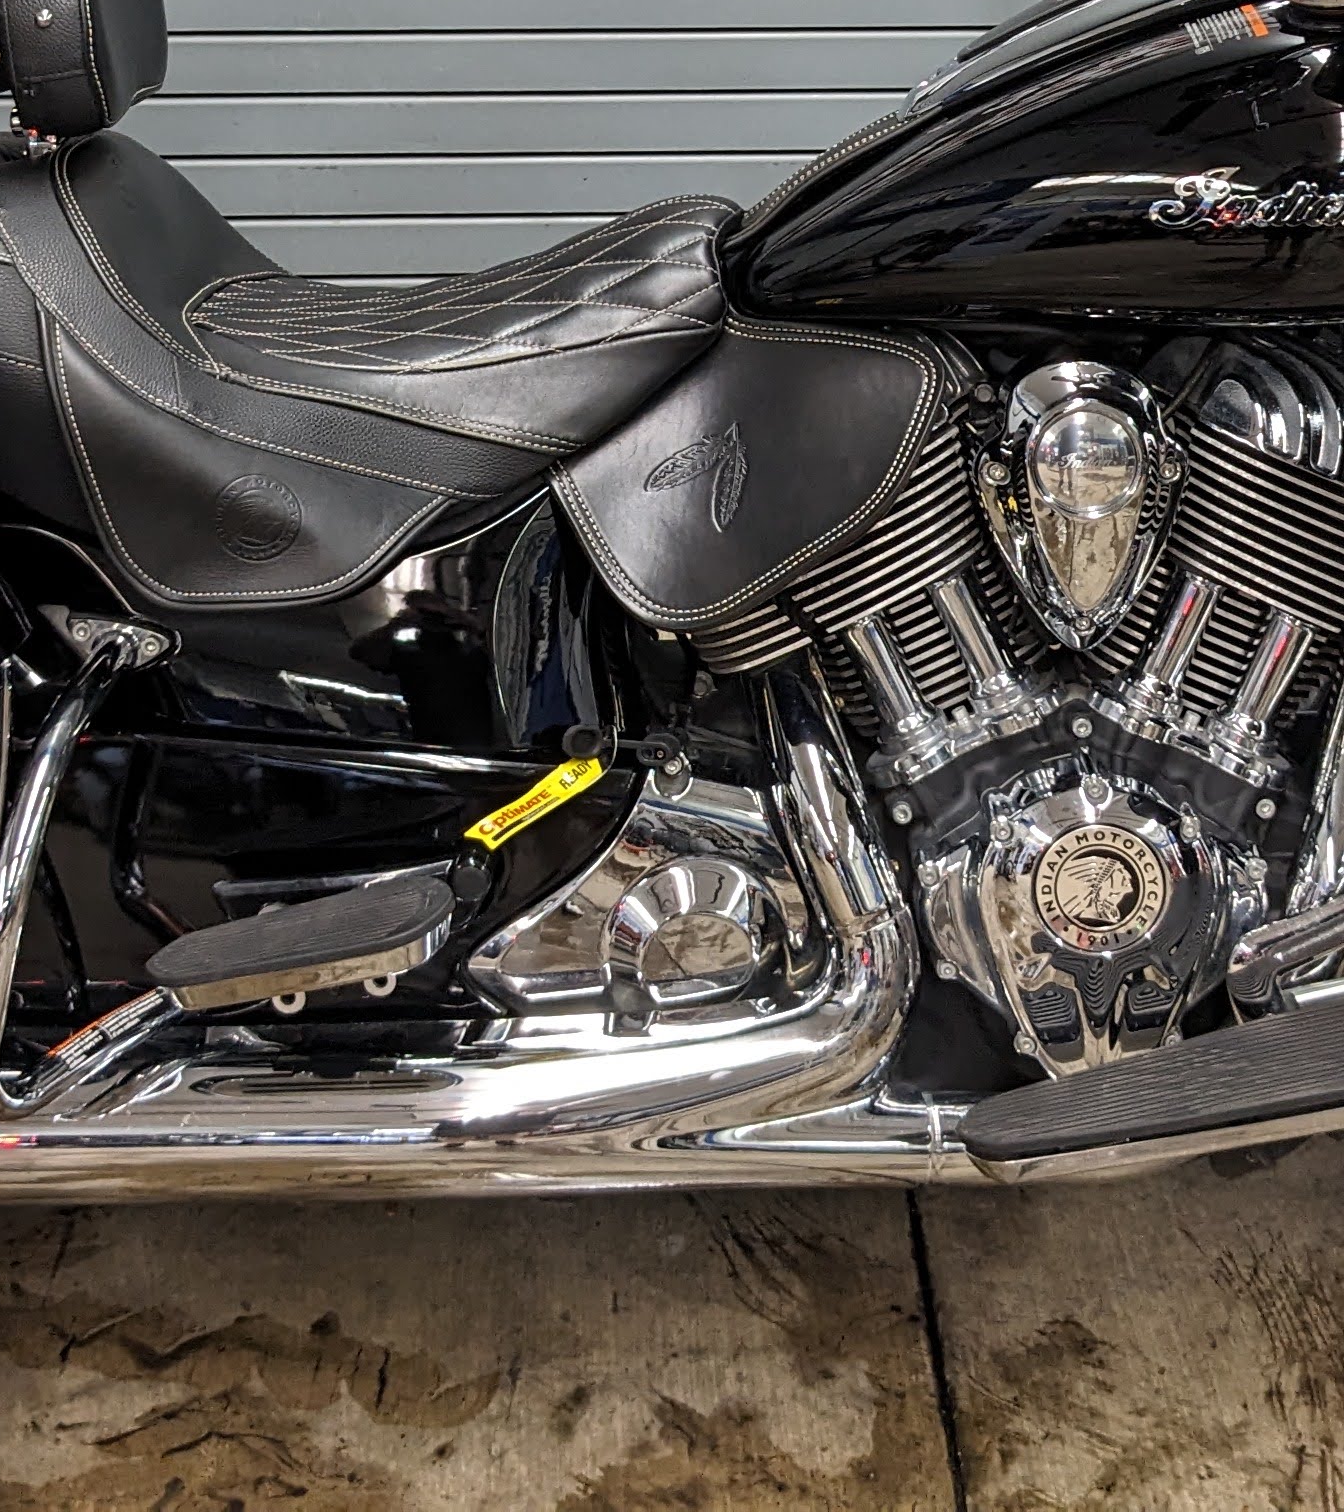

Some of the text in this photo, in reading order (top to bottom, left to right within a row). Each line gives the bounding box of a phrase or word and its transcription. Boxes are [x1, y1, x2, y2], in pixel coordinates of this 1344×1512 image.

[1041, 829, 1160, 928] INDIAN MOTORCYCLE
[1076, 931, 1120, 946] 1901
